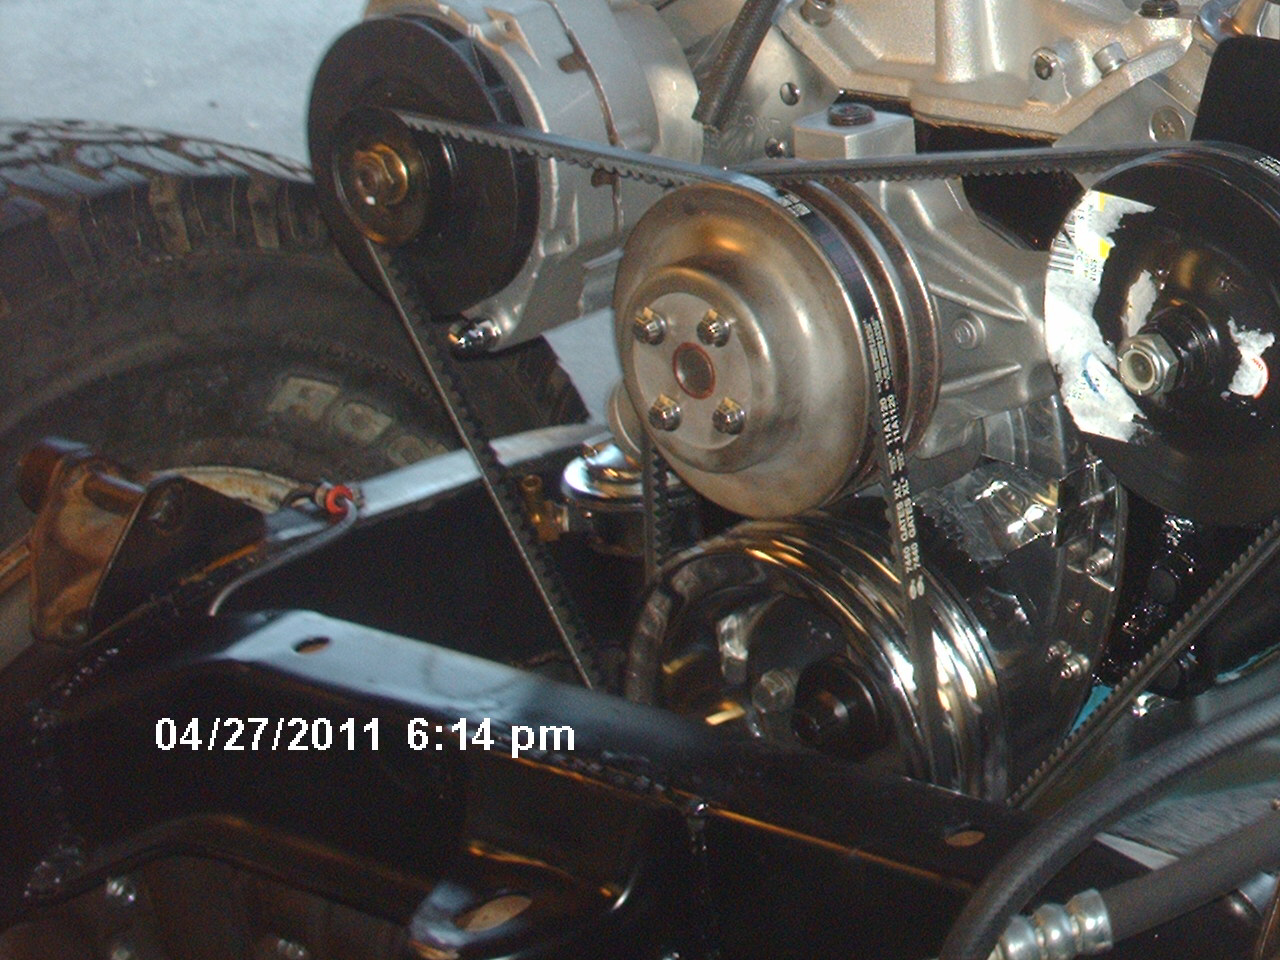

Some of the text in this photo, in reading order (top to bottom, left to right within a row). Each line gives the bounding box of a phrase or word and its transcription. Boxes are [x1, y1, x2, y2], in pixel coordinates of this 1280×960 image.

[880, 397, 893, 446] 11A1120
[887, 394, 901, 443] 11A1120
[896, 501, 908, 541] GATES
[904, 497, 916, 538] GATES
